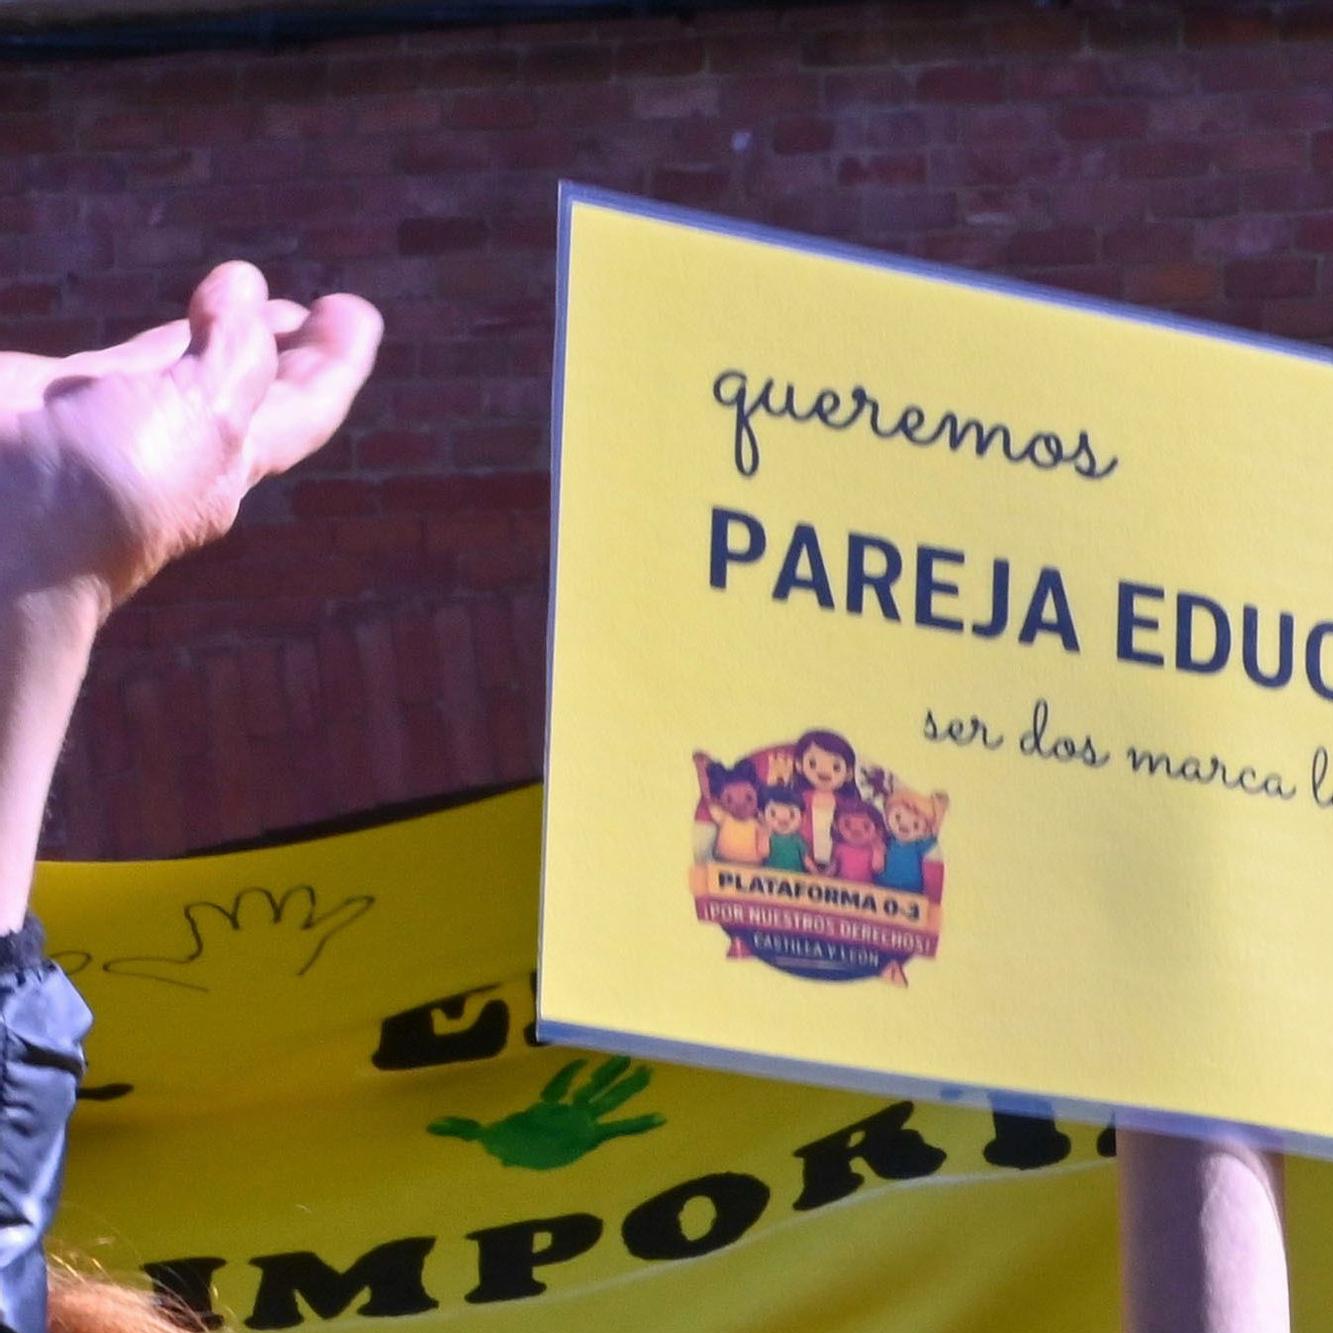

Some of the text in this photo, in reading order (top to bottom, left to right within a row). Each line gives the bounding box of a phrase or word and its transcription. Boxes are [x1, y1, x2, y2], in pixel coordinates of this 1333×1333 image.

[712, 369, 1120, 480] queremos
[709, 505, 1081, 654] PAREJA
[922, 709, 1004, 750] ser
[1018, 699, 1111, 768] dos
[1126, 745, 1297, 801] marca
[718, 871, 921, 921] PLATAFORMA 0-3
[749, 907, 835, 937] NUESTROS
[839, 921, 931, 953] DERECHOS!
[753, 931, 823, 958] CASTILLA
